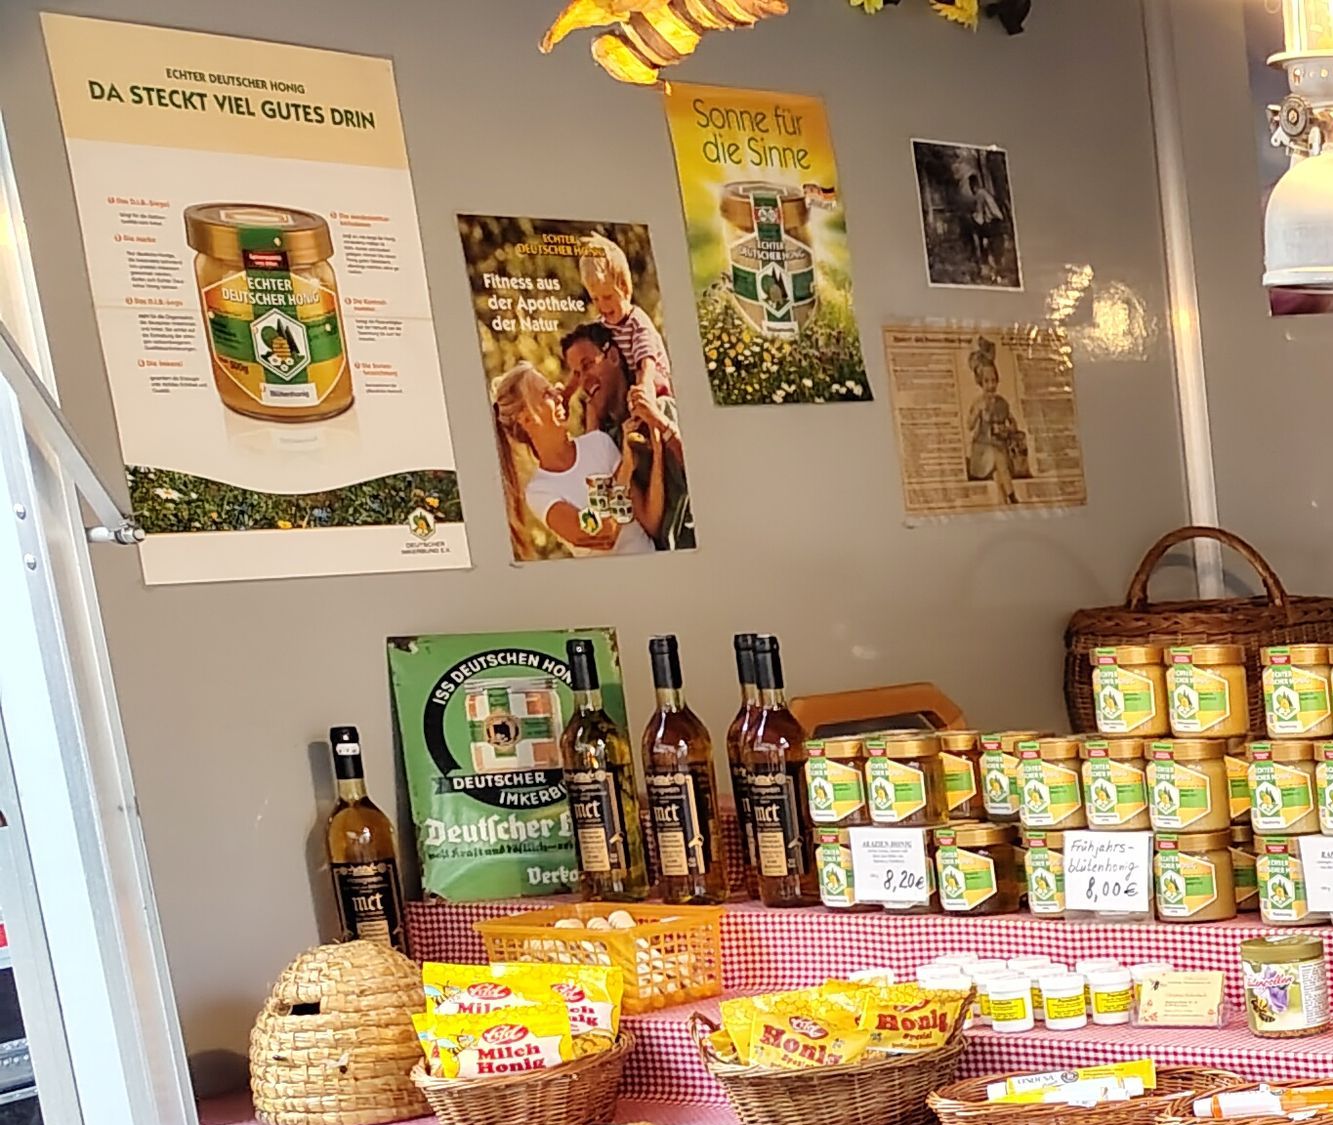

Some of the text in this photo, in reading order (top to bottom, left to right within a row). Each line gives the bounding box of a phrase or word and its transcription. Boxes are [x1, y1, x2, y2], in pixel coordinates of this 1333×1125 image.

[166, 68, 305, 95] ECHTER DEUTSCHER HONIG
[88, 79, 376, 130] DA STECKT VIEL GUTES DRIN
[693, 99, 802, 138] Sonne für
[703, 134, 811, 171] die Sinne
[247, 277, 293, 291] ECHTER
[483, 272, 561, 290] Fitness aus
[488, 296, 586, 314] der Apotheke
[491, 317, 560, 332] der Natur
[432, 652, 573, 706] ISS DEUTSCHEN HON
[453, 772, 547, 790] DEUTSCHER
[1070, 840, 1135, 859] Frühjahrs-
[1068, 860, 1139, 880] blütenhonig
[876, 1008, 949, 1033] Honig
[478, 1044, 541, 1060] Milch
[760, 1024, 843, 1065] Honig
[477, 1058, 546, 1074] Honig
